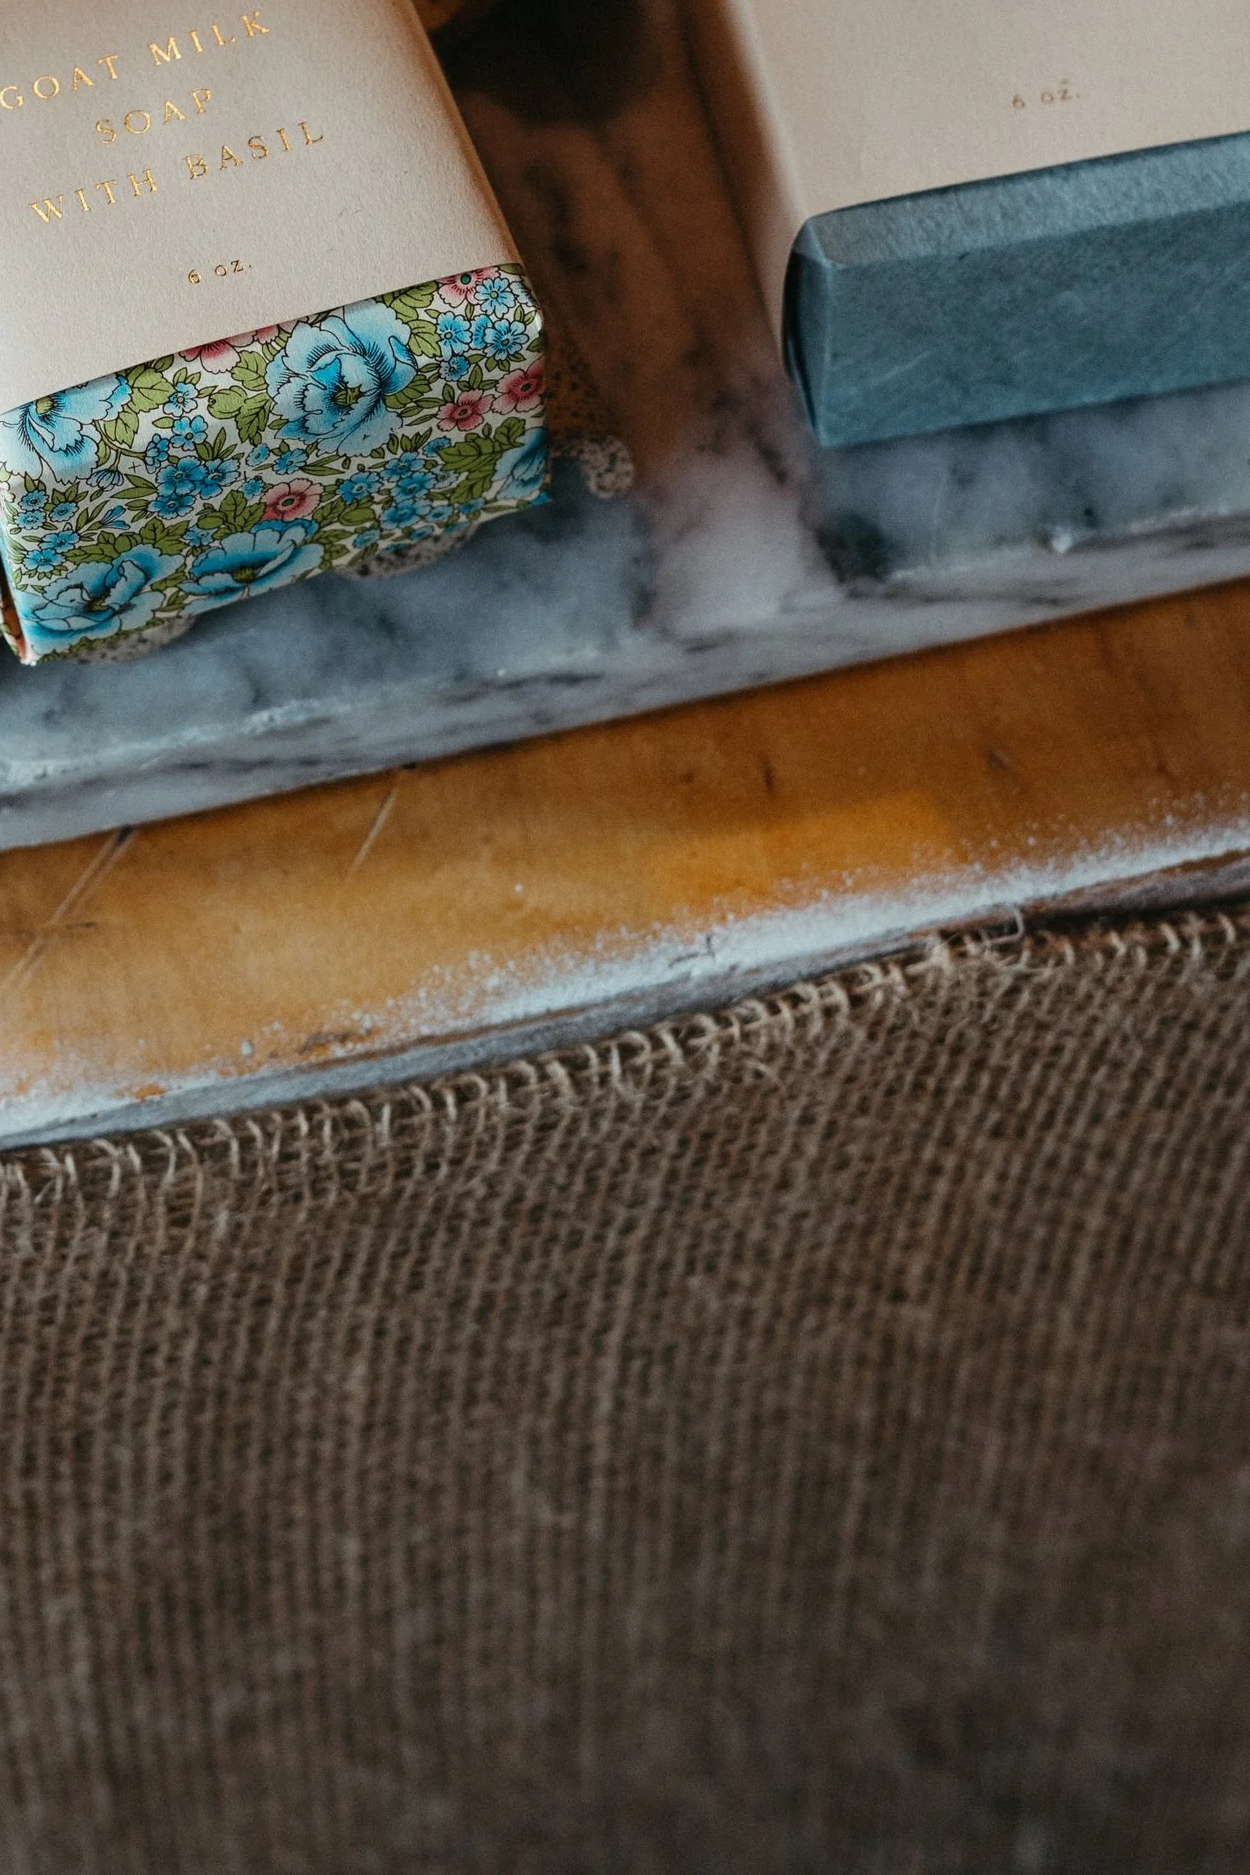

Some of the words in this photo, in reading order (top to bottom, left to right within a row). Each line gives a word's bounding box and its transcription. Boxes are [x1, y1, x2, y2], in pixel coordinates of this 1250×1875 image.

[147, 11, 270, 66] MILK
[94, 88, 214, 144] SOAP
[1012, 95, 1026, 109] 6
[30, 168, 159, 224] WITH
[184, 121, 323, 180] BASIL
[188, 269, 202, 285] 6
